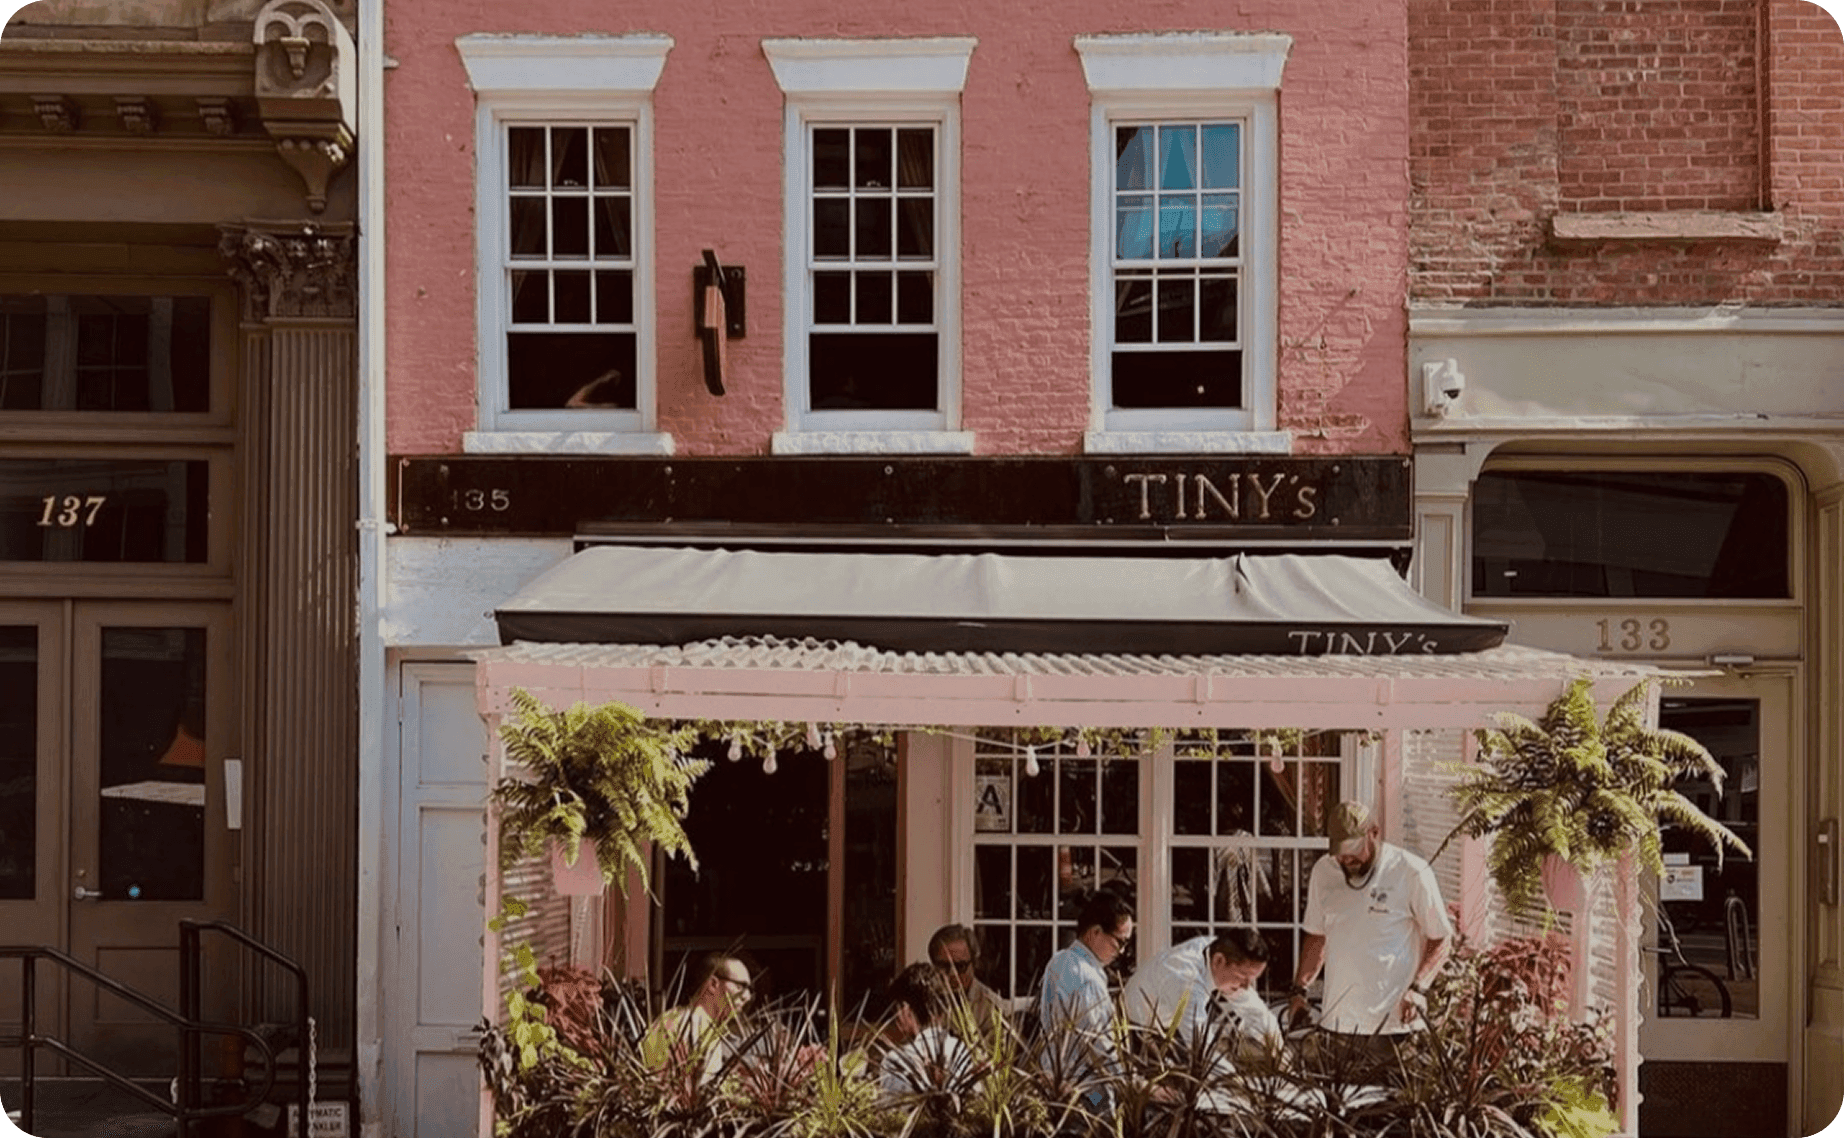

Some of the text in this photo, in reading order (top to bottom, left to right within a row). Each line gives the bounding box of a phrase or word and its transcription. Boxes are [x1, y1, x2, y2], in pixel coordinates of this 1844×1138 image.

[36, 495, 106, 527] 137
[453, 488, 510, 512] 135
[1124, 473, 1317, 519] TINY's
[1596, 618, 1671, 652] 133
[976, 784, 1003, 815] A
